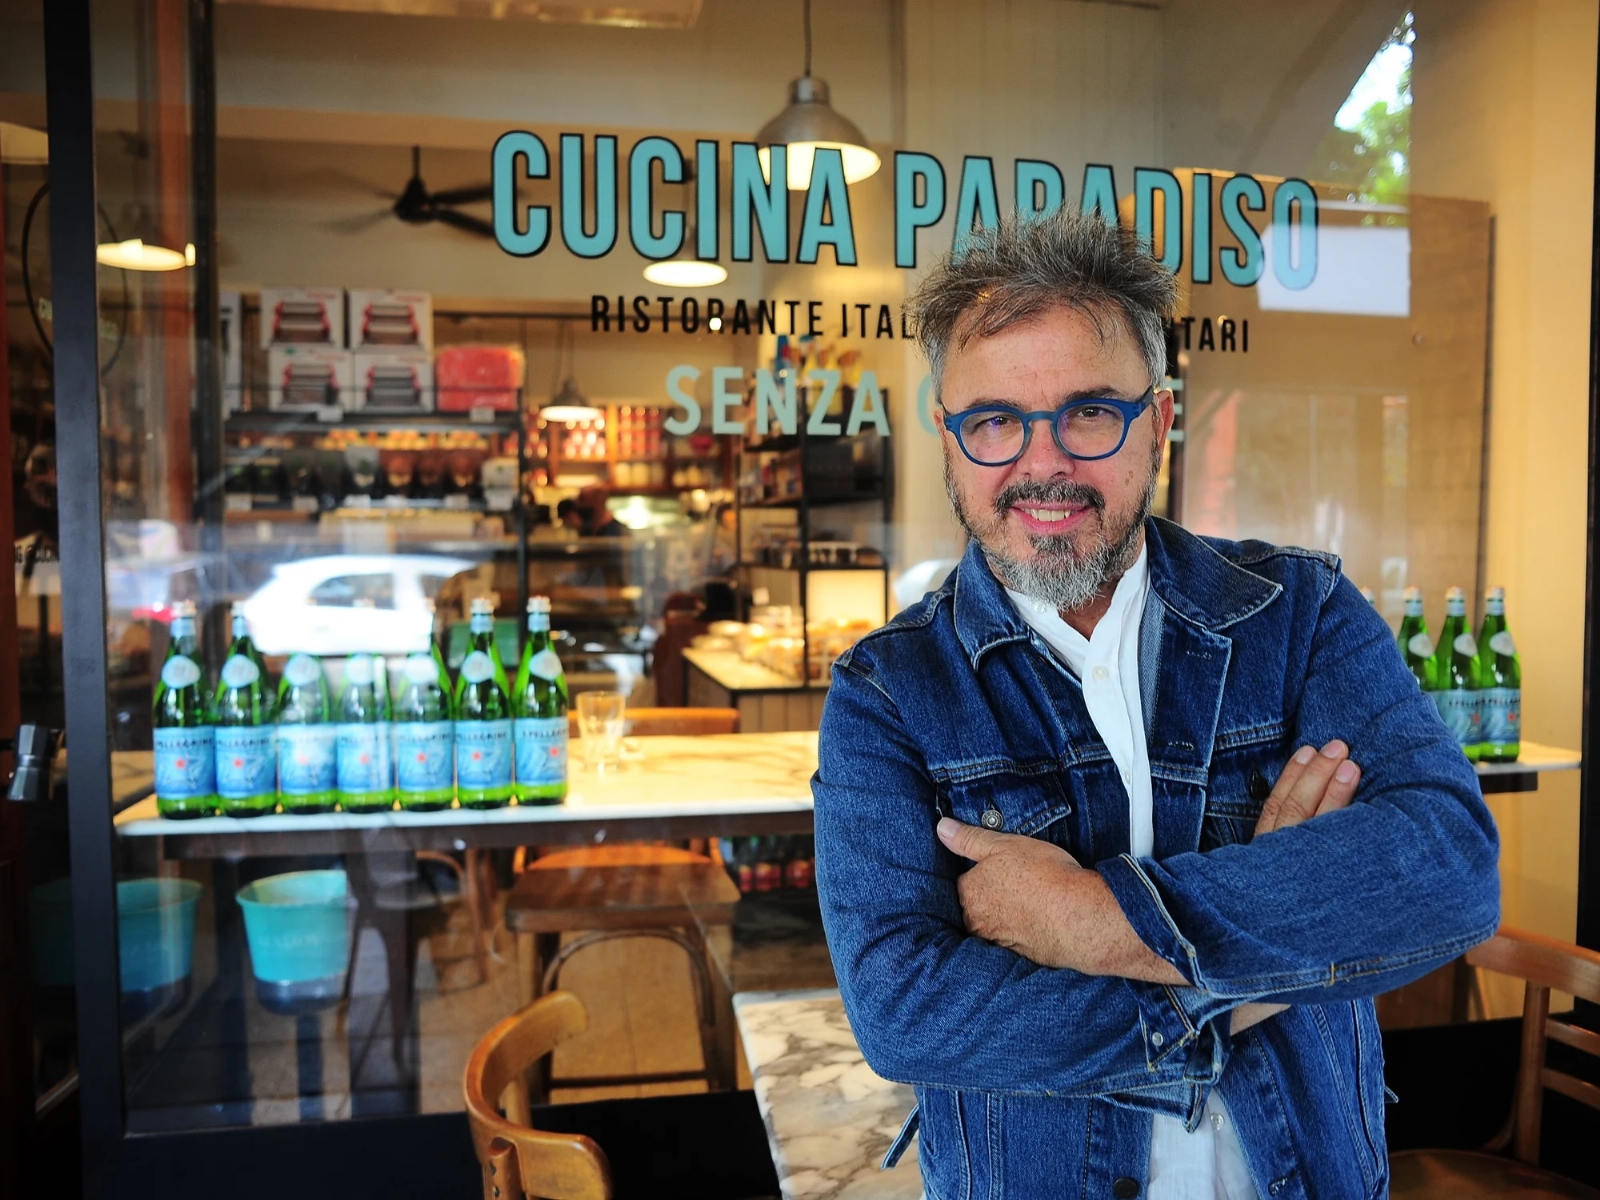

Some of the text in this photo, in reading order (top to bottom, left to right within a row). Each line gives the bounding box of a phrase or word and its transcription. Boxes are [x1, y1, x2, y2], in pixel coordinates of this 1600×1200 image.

[492, 130, 1319, 291] CUCINA PARADISO
[590, 295, 1248, 353] RISTORANTE ITAL TARI
[664, 365, 891, 437] SENZA
